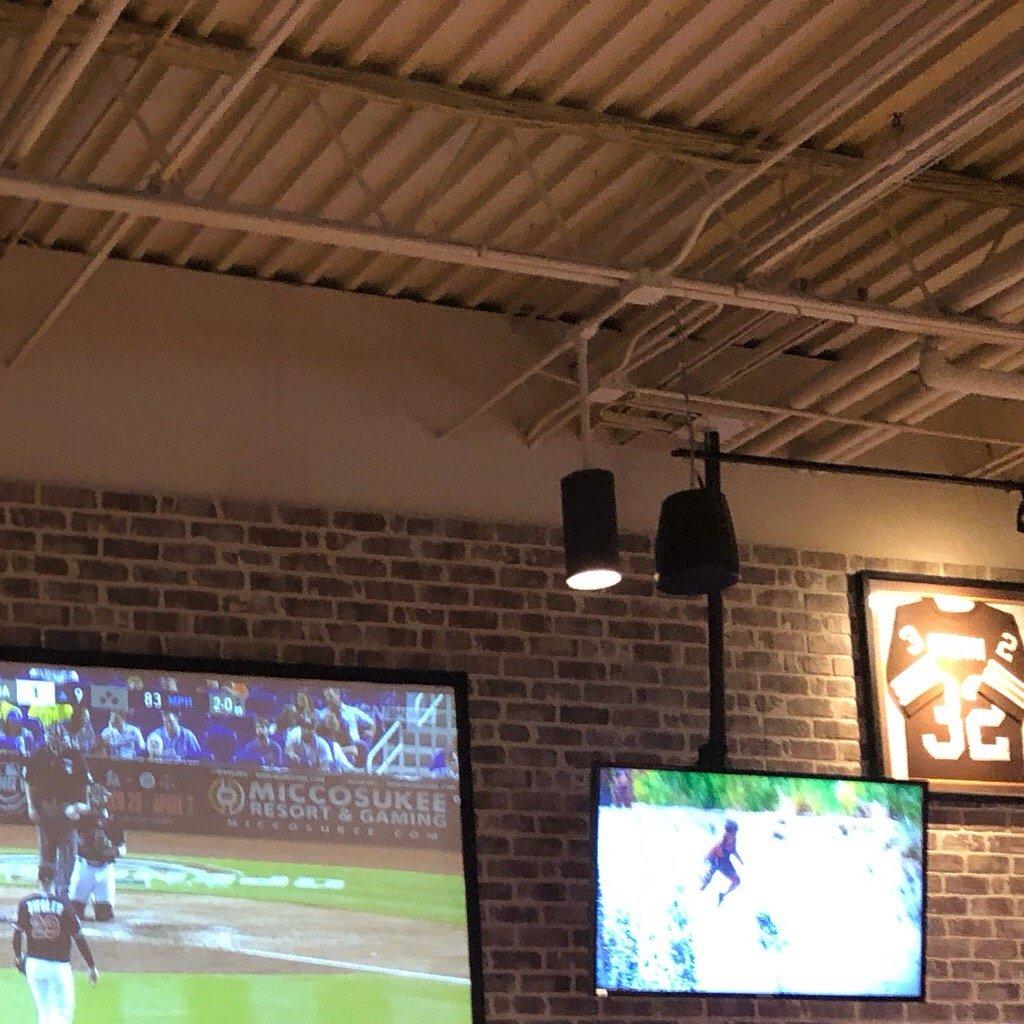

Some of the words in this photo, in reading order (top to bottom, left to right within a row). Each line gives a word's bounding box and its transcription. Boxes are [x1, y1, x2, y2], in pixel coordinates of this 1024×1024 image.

[994, 632, 1019, 664] 2
[144, 691, 162, 709] 83
[921, 673, 1012, 762] 32
[248, 781, 447, 813] MICCOSUKEE
[249, 800, 331, 821] RESORT
[338, 807, 353, 823] &
[359, 808, 447, 829] GAMING
